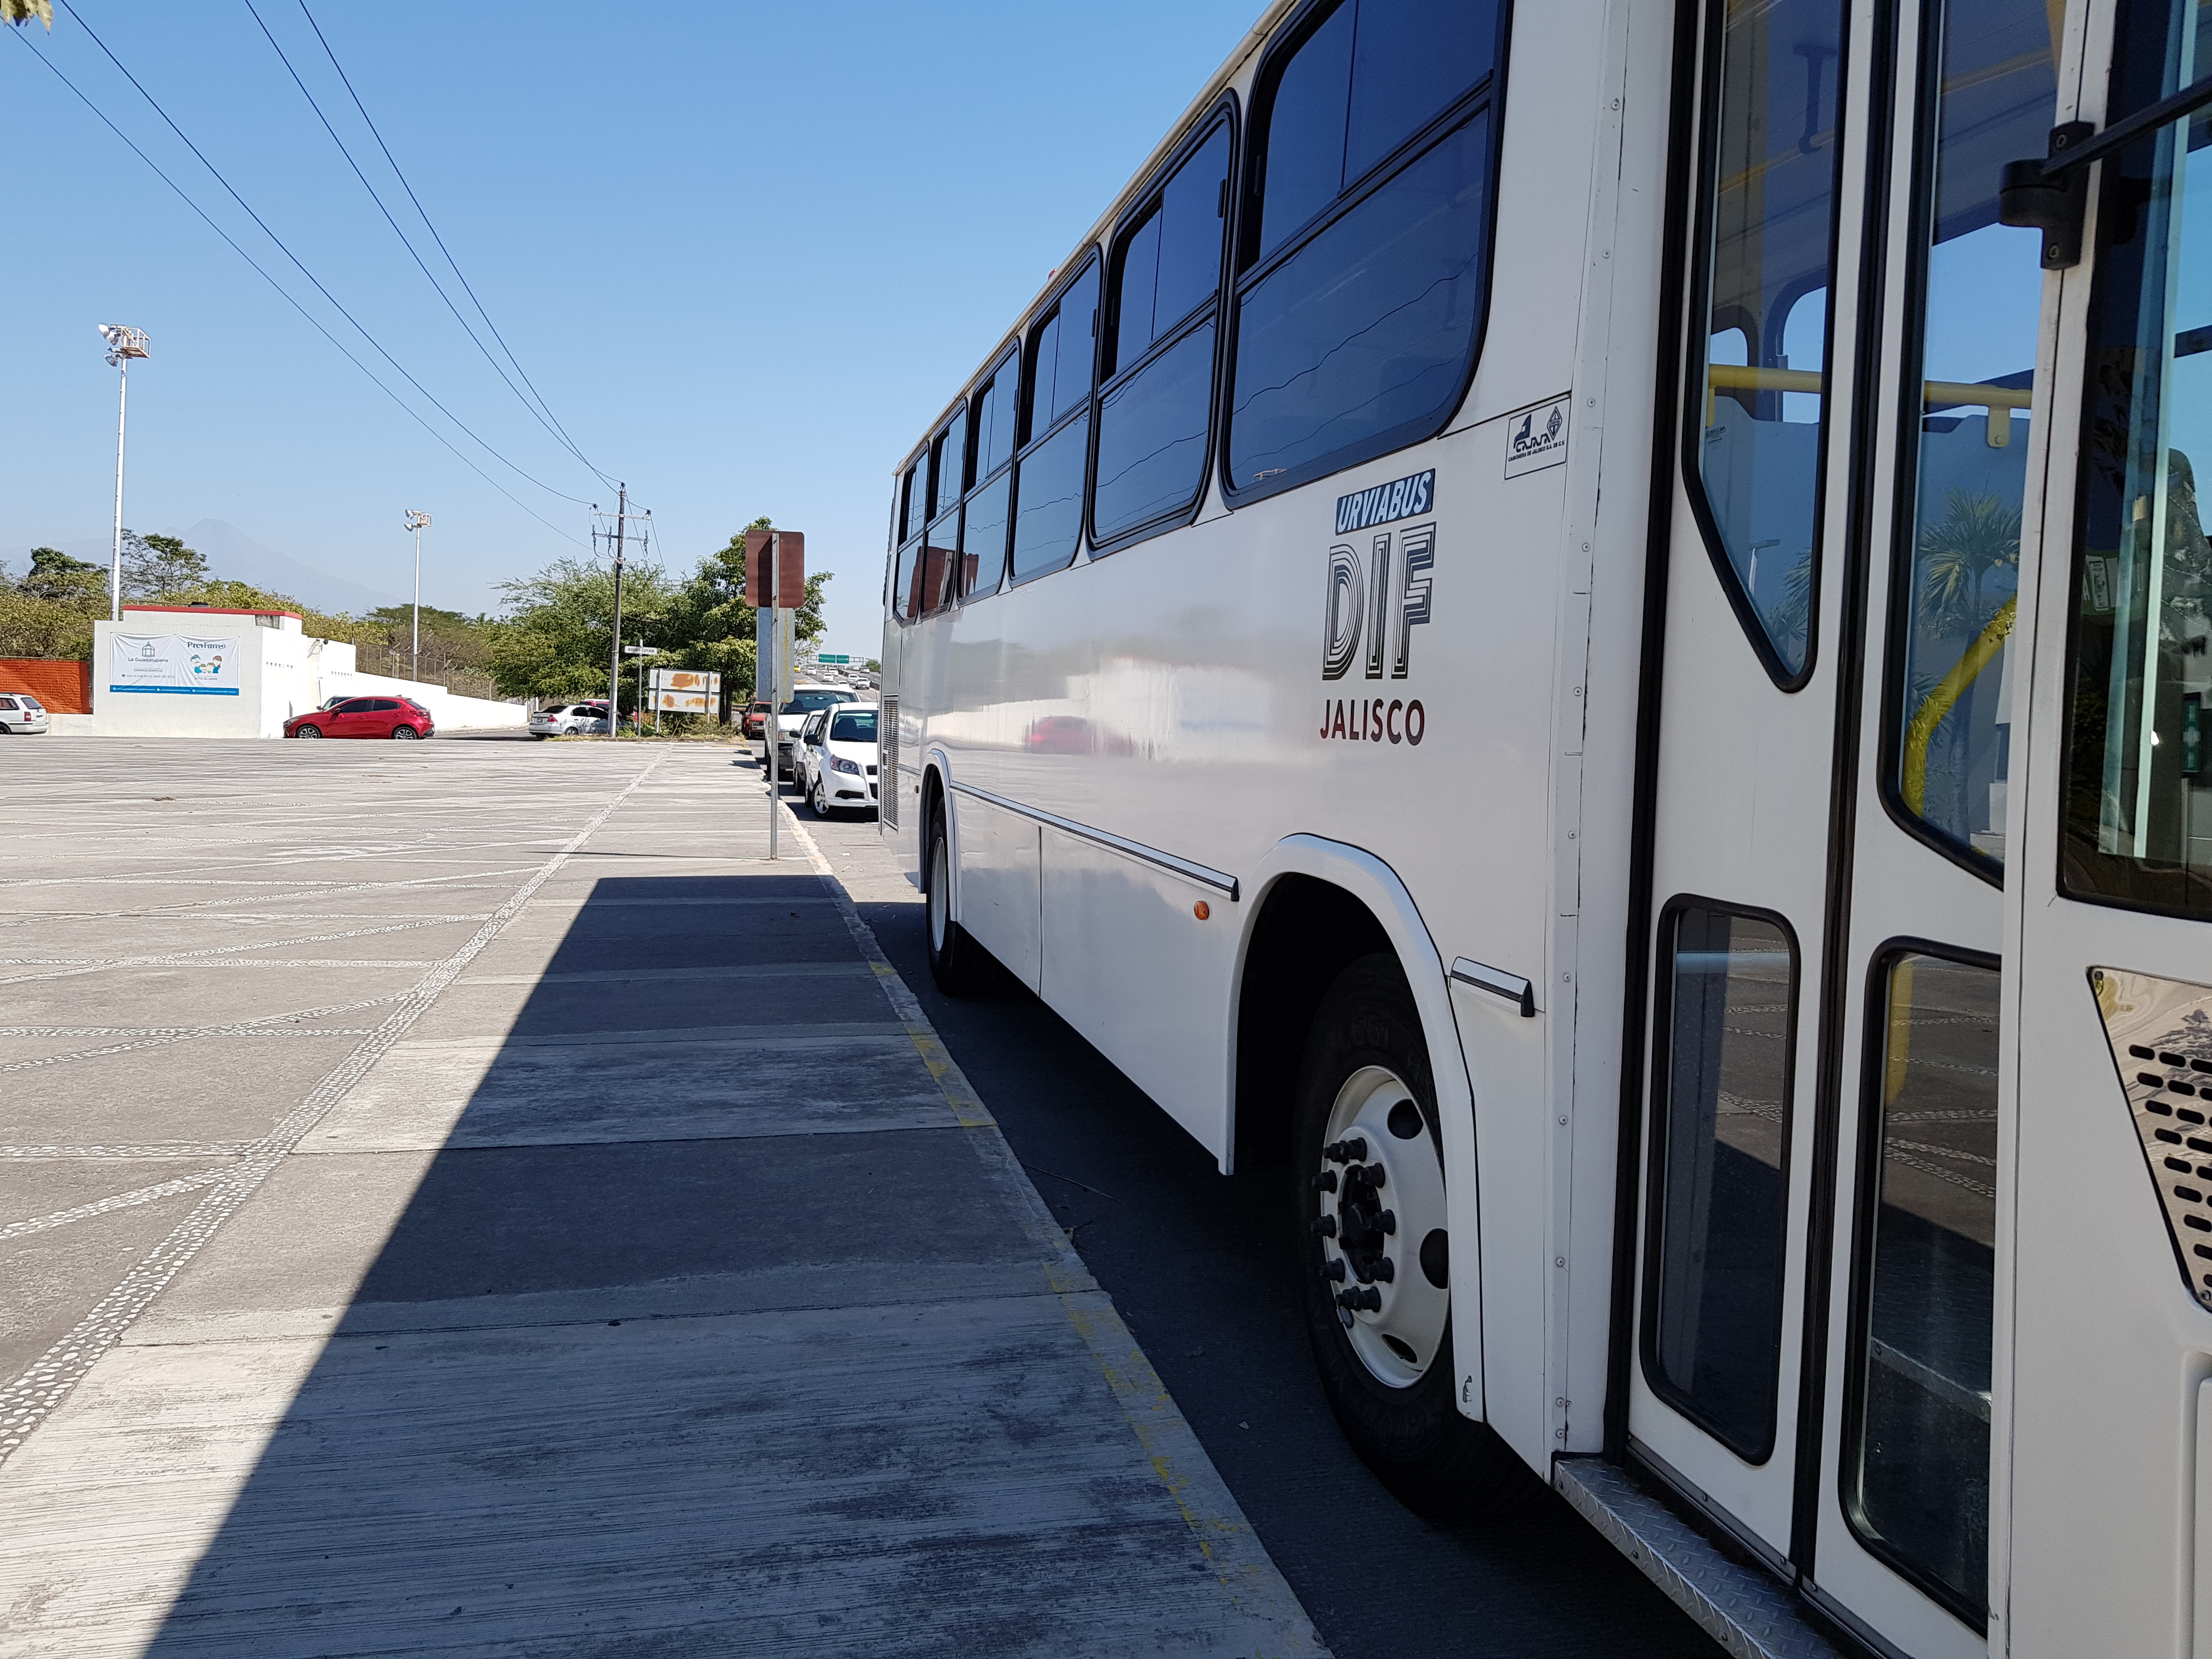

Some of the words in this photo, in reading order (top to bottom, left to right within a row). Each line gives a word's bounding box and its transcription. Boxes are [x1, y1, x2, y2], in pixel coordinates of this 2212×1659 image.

[1532, 446, 1545, 455] JALISCO
[1337, 471, 1432, 533] URVIABUS
[1322, 522, 1436, 680] DIF
[1321, 698, 1425, 746] JALISCO
